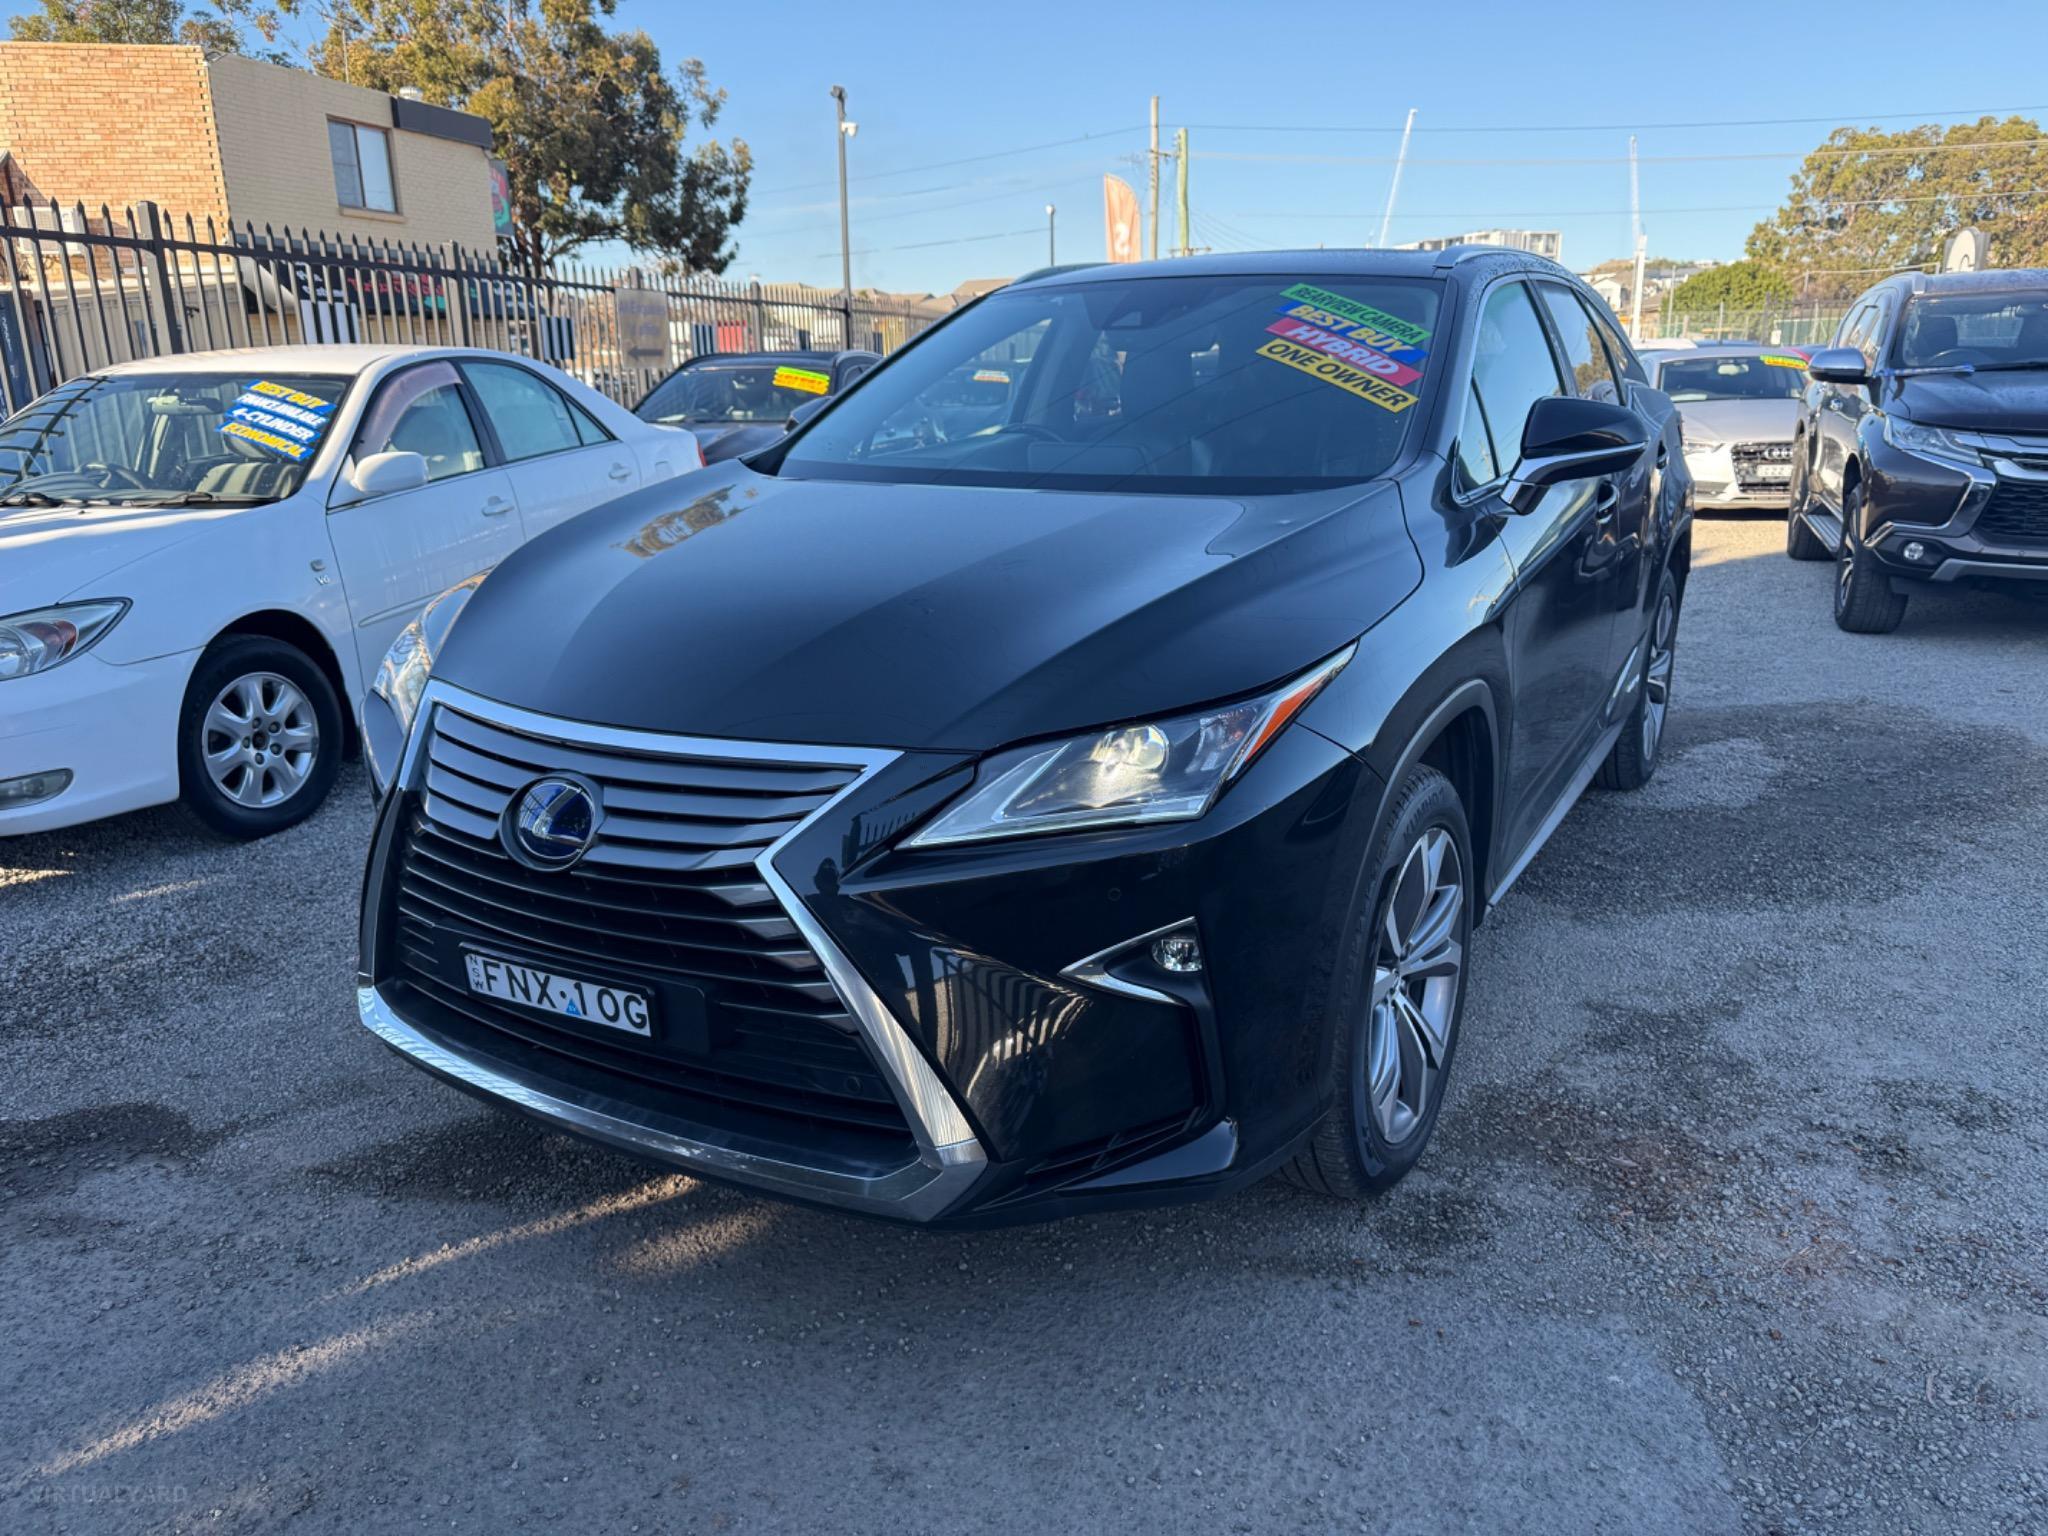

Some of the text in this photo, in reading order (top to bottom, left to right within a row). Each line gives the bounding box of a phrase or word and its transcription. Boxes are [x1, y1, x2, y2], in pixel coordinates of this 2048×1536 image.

[1287, 304, 1414, 353] BEST BUY
[1293, 286, 1423, 341] REARVIEW CAMERA
[1266, 343, 1409, 407] ONE OWNER
[1285, 324, 1400, 375] HYBRID
